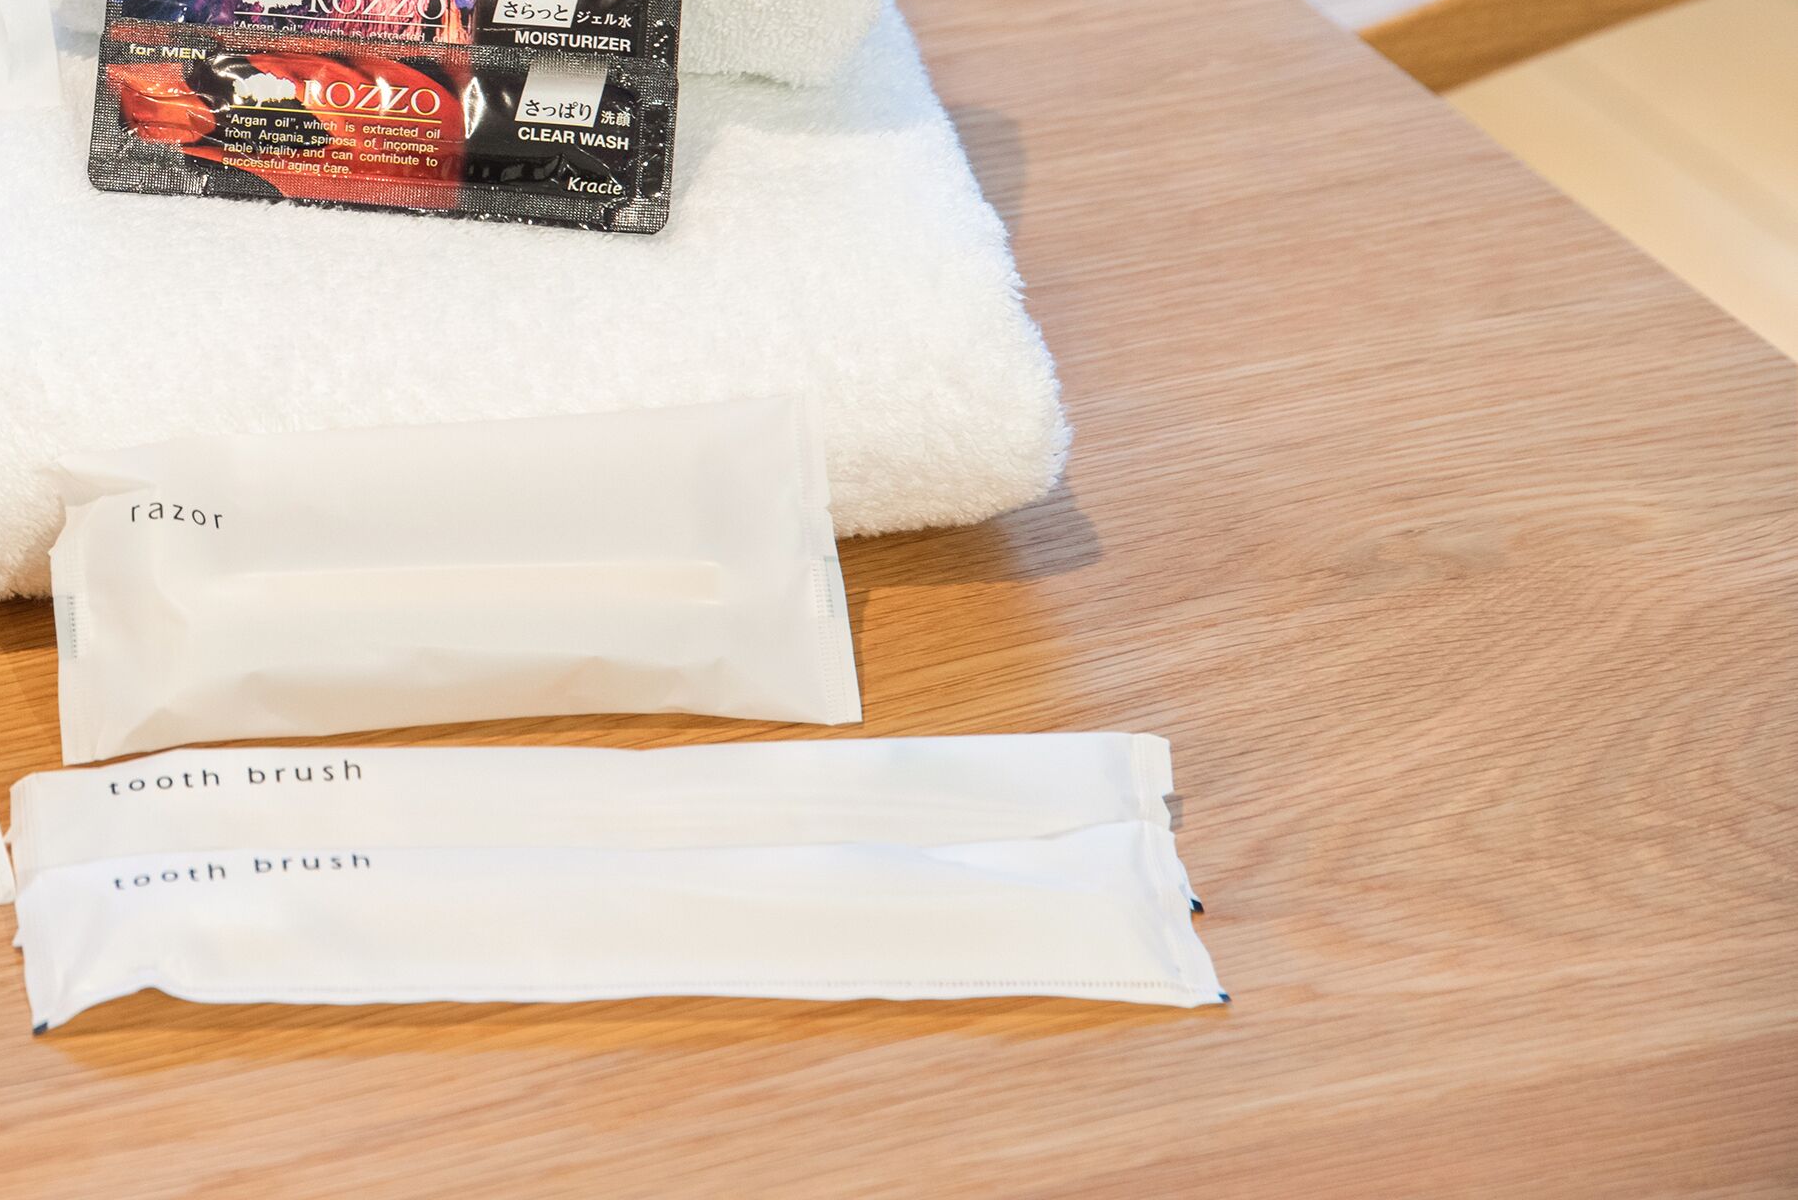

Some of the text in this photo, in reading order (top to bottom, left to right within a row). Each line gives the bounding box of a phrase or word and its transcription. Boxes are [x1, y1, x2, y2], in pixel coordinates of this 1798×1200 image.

[503, 1, 569, 22] さらっと
[576, 10, 632, 29] ジェル水
[129, 43, 207, 59] for MEN
[514, 30, 632, 53] MOISTURIZER
[300, 79, 441, 116] ROZZO
[525, 99, 592, 122] さっぱり
[600, 109, 631, 127] 洗顔
[224, 127, 252, 140] from
[258, 130, 303, 144] Argania
[311, 134, 356, 147] spinosa
[364, 137, 377, 148] of
[303, 118, 337, 131] which
[345, 122, 355, 133] is
[362, 124, 419, 138] extracted
[426, 128, 440, 140] oil
[517, 126, 630, 151] CLEAR WASH
[222, 155, 285, 171] successful
[287, 161, 320, 175] aging
[223, 141, 252, 153] rable
[303, 147, 325, 159] and
[331, 151, 353, 161] can
[359, 151, 420, 166] contribute
[426, 157, 438, 167] to
[567, 175, 623, 196] Kracie
[130, 500, 223, 529] razor
[109, 759, 363, 796] tooth brush
[114, 852, 372, 891] tooth brush
